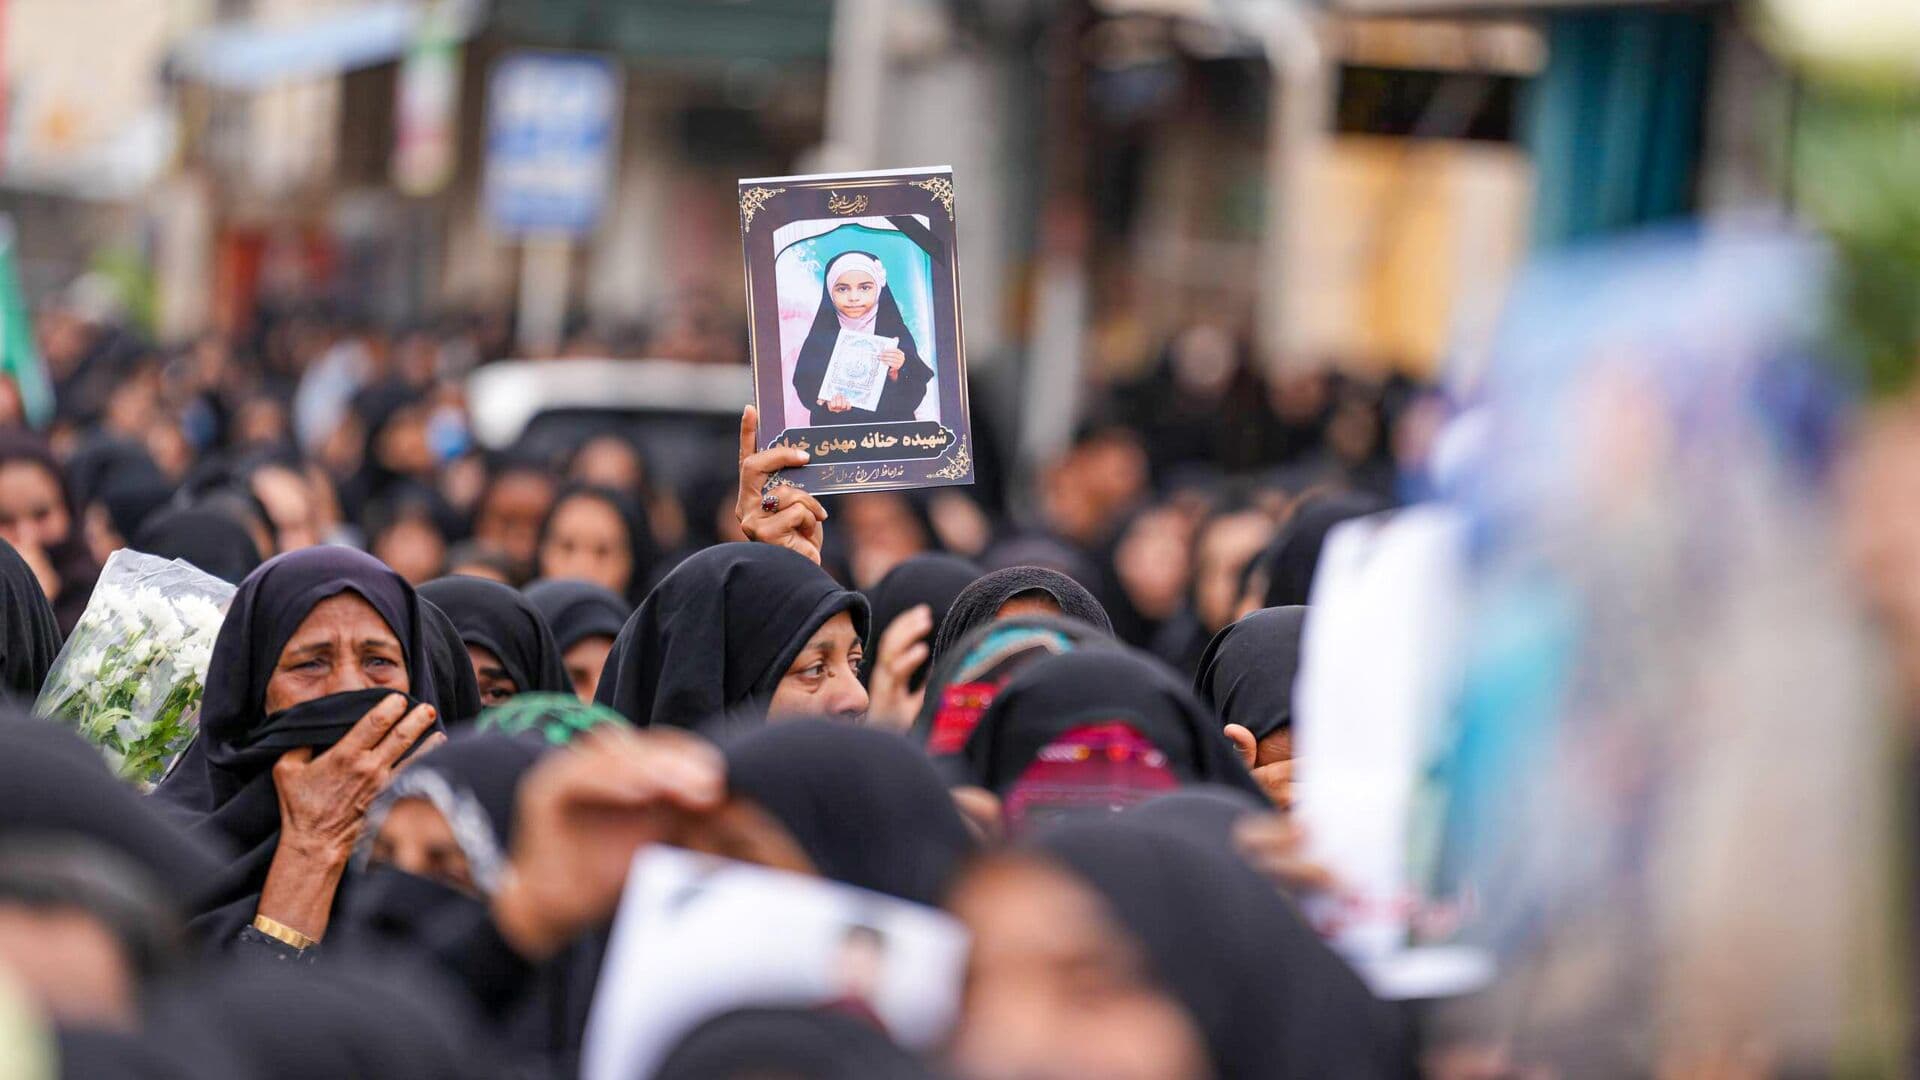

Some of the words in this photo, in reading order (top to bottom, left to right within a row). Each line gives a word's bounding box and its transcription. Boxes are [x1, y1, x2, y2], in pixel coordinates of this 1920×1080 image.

[814, 437, 857, 457] مهدی
[861, 432, 899, 449] حنانه
[902, 429, 947, 450] شهیده
